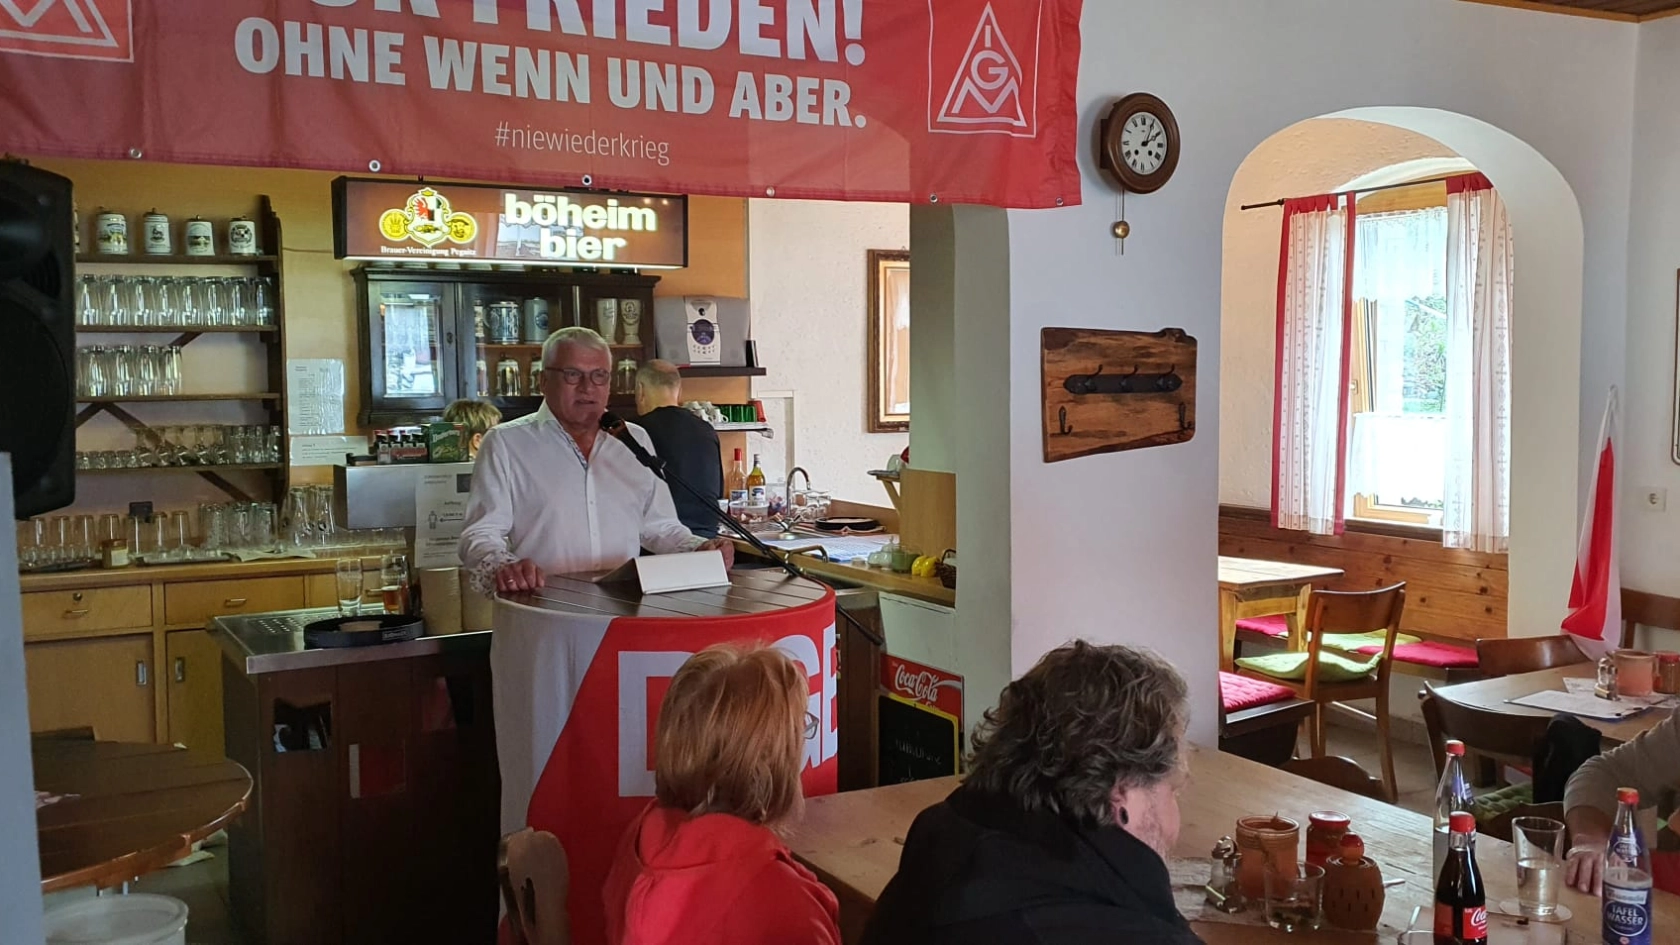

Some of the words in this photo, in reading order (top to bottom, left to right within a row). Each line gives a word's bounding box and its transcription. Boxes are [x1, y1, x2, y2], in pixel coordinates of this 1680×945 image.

[234, 17, 406, 86] OHNE
[423, 35, 591, 104] WENN
[607, 56, 715, 115] UND
[728, 71, 867, 128] ABER.
[495, 120, 670, 166] #niewiederkrieg
[504, 193, 658, 231] böheim
[540, 227, 627, 261] bier
[895, 664, 938, 702] Coca-Cola
[1607, 911, 1644, 926] WASSER
[1612, 905, 1640, 917] TAFEL
